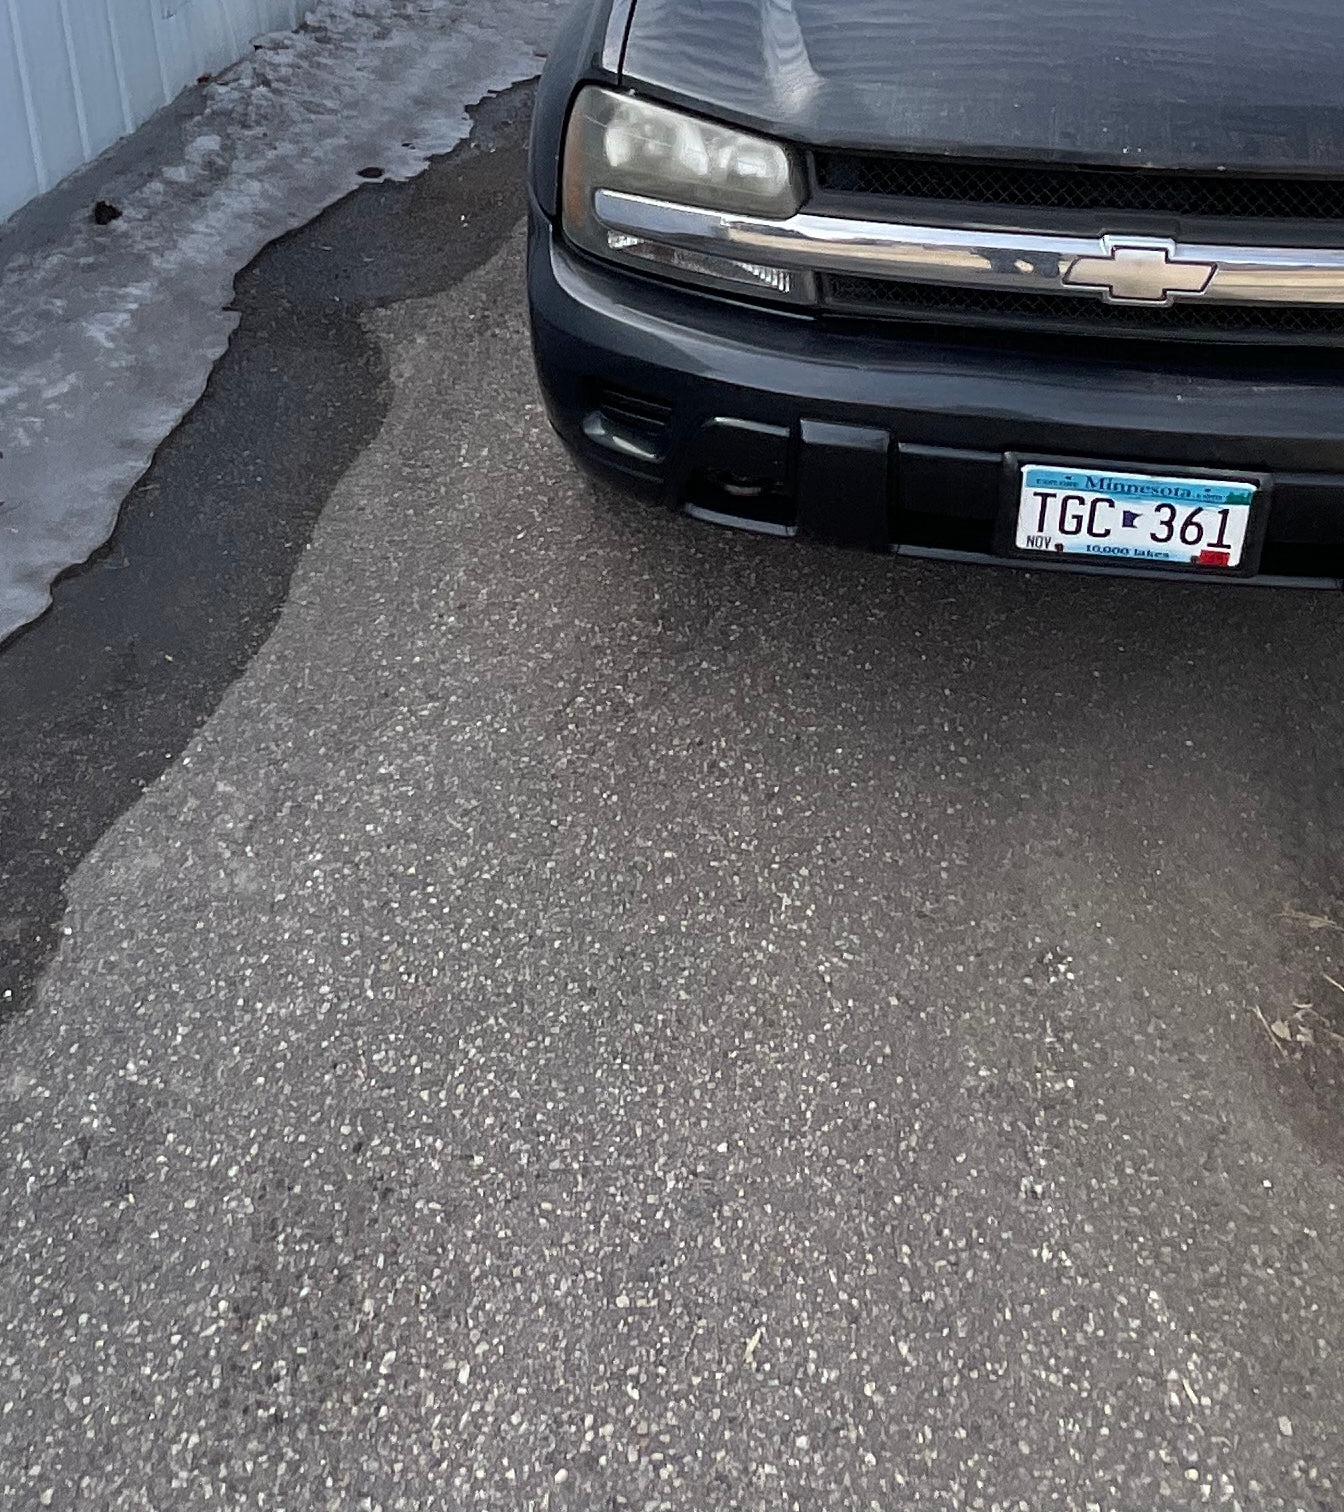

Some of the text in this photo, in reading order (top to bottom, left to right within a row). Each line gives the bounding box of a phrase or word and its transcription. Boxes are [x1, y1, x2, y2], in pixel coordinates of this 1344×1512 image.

[1085, 475, 1191, 498] Minnesota
[1033, 491, 1232, 549] TGC 361
[1026, 535, 1052, 550] NOV
